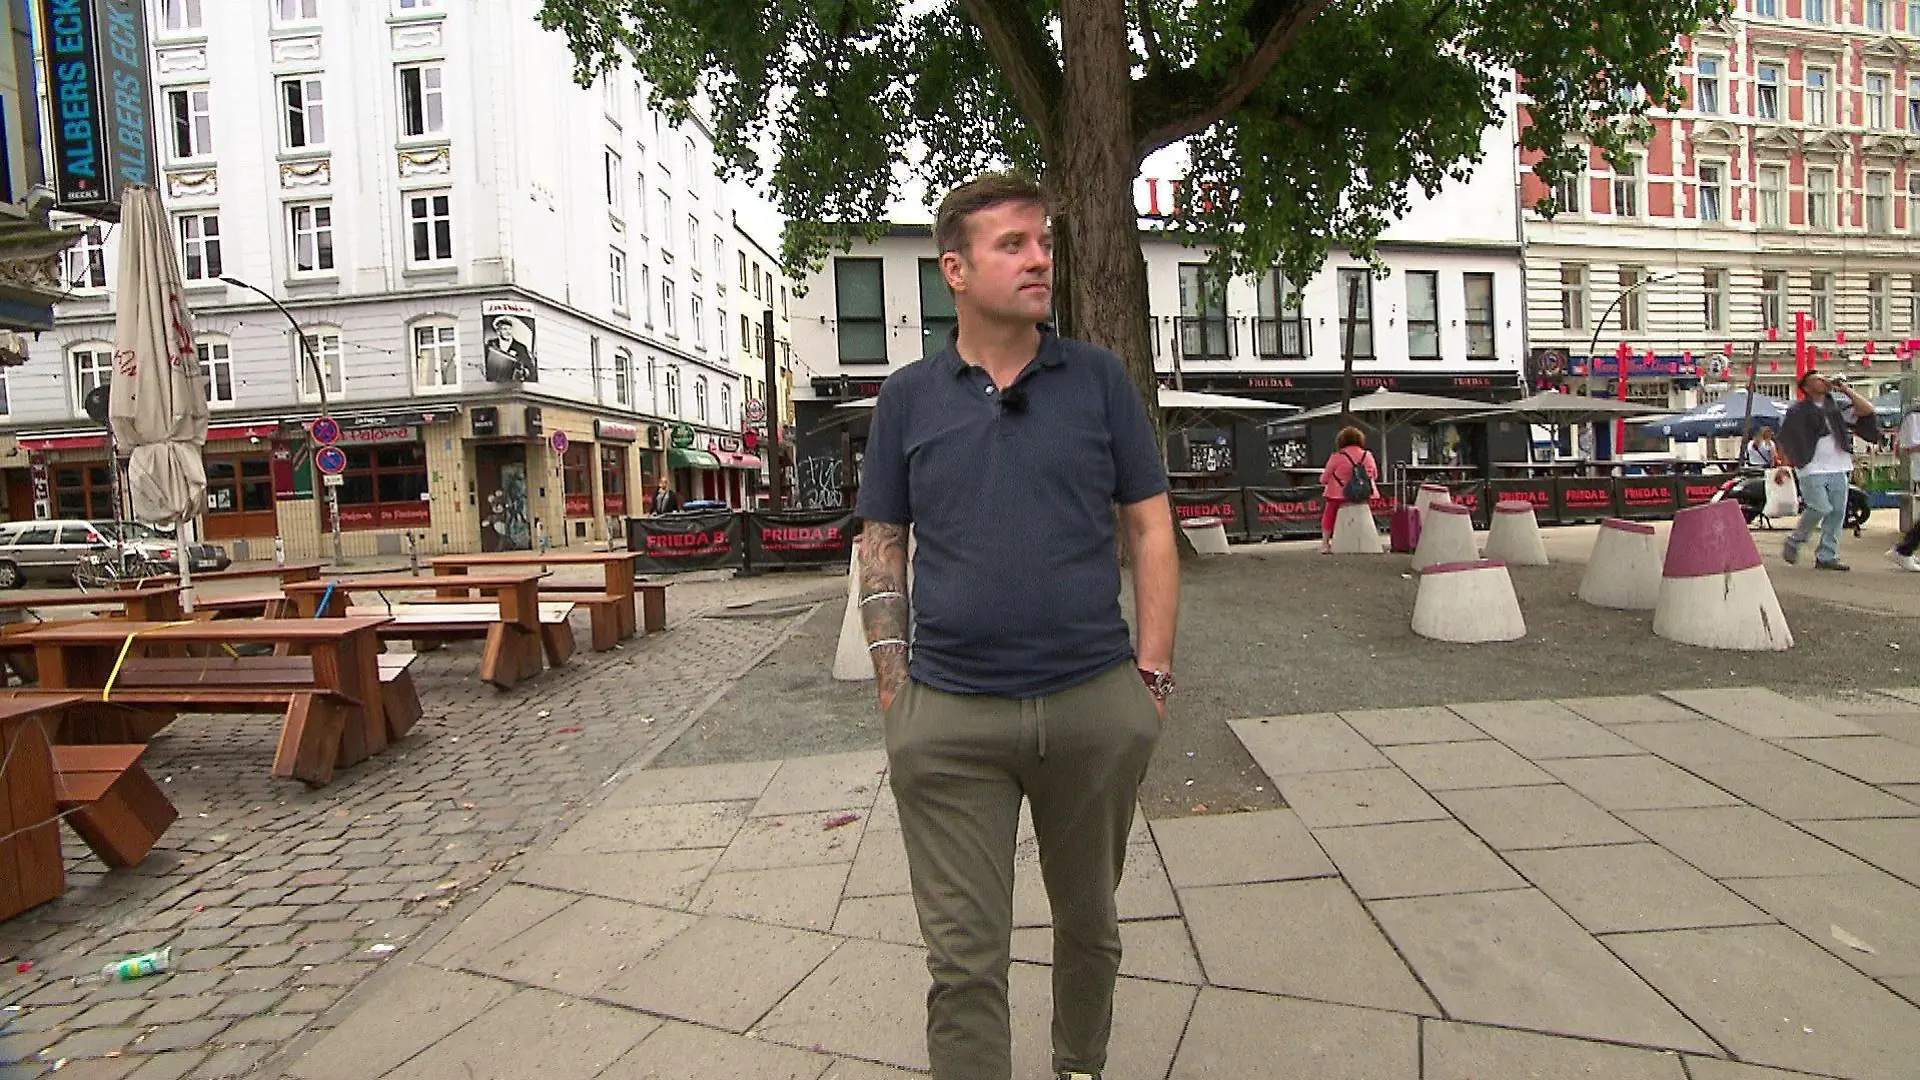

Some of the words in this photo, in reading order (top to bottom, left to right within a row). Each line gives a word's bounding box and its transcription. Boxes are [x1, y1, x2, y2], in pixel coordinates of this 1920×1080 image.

[51, 0, 84, 53] ECK
[58, 61, 95, 177] ALBERS
[112, 69, 147, 186] ALBERS
[1175, 502, 1220, 517] FRIEDA
[1258, 501, 1302, 514] FRIEDA
[647, 532, 708, 549] FRIEDA
[713, 530, 729, 545] B.
[763, 527, 823, 542] FRIEDA
[827, 526, 843, 540] B.
